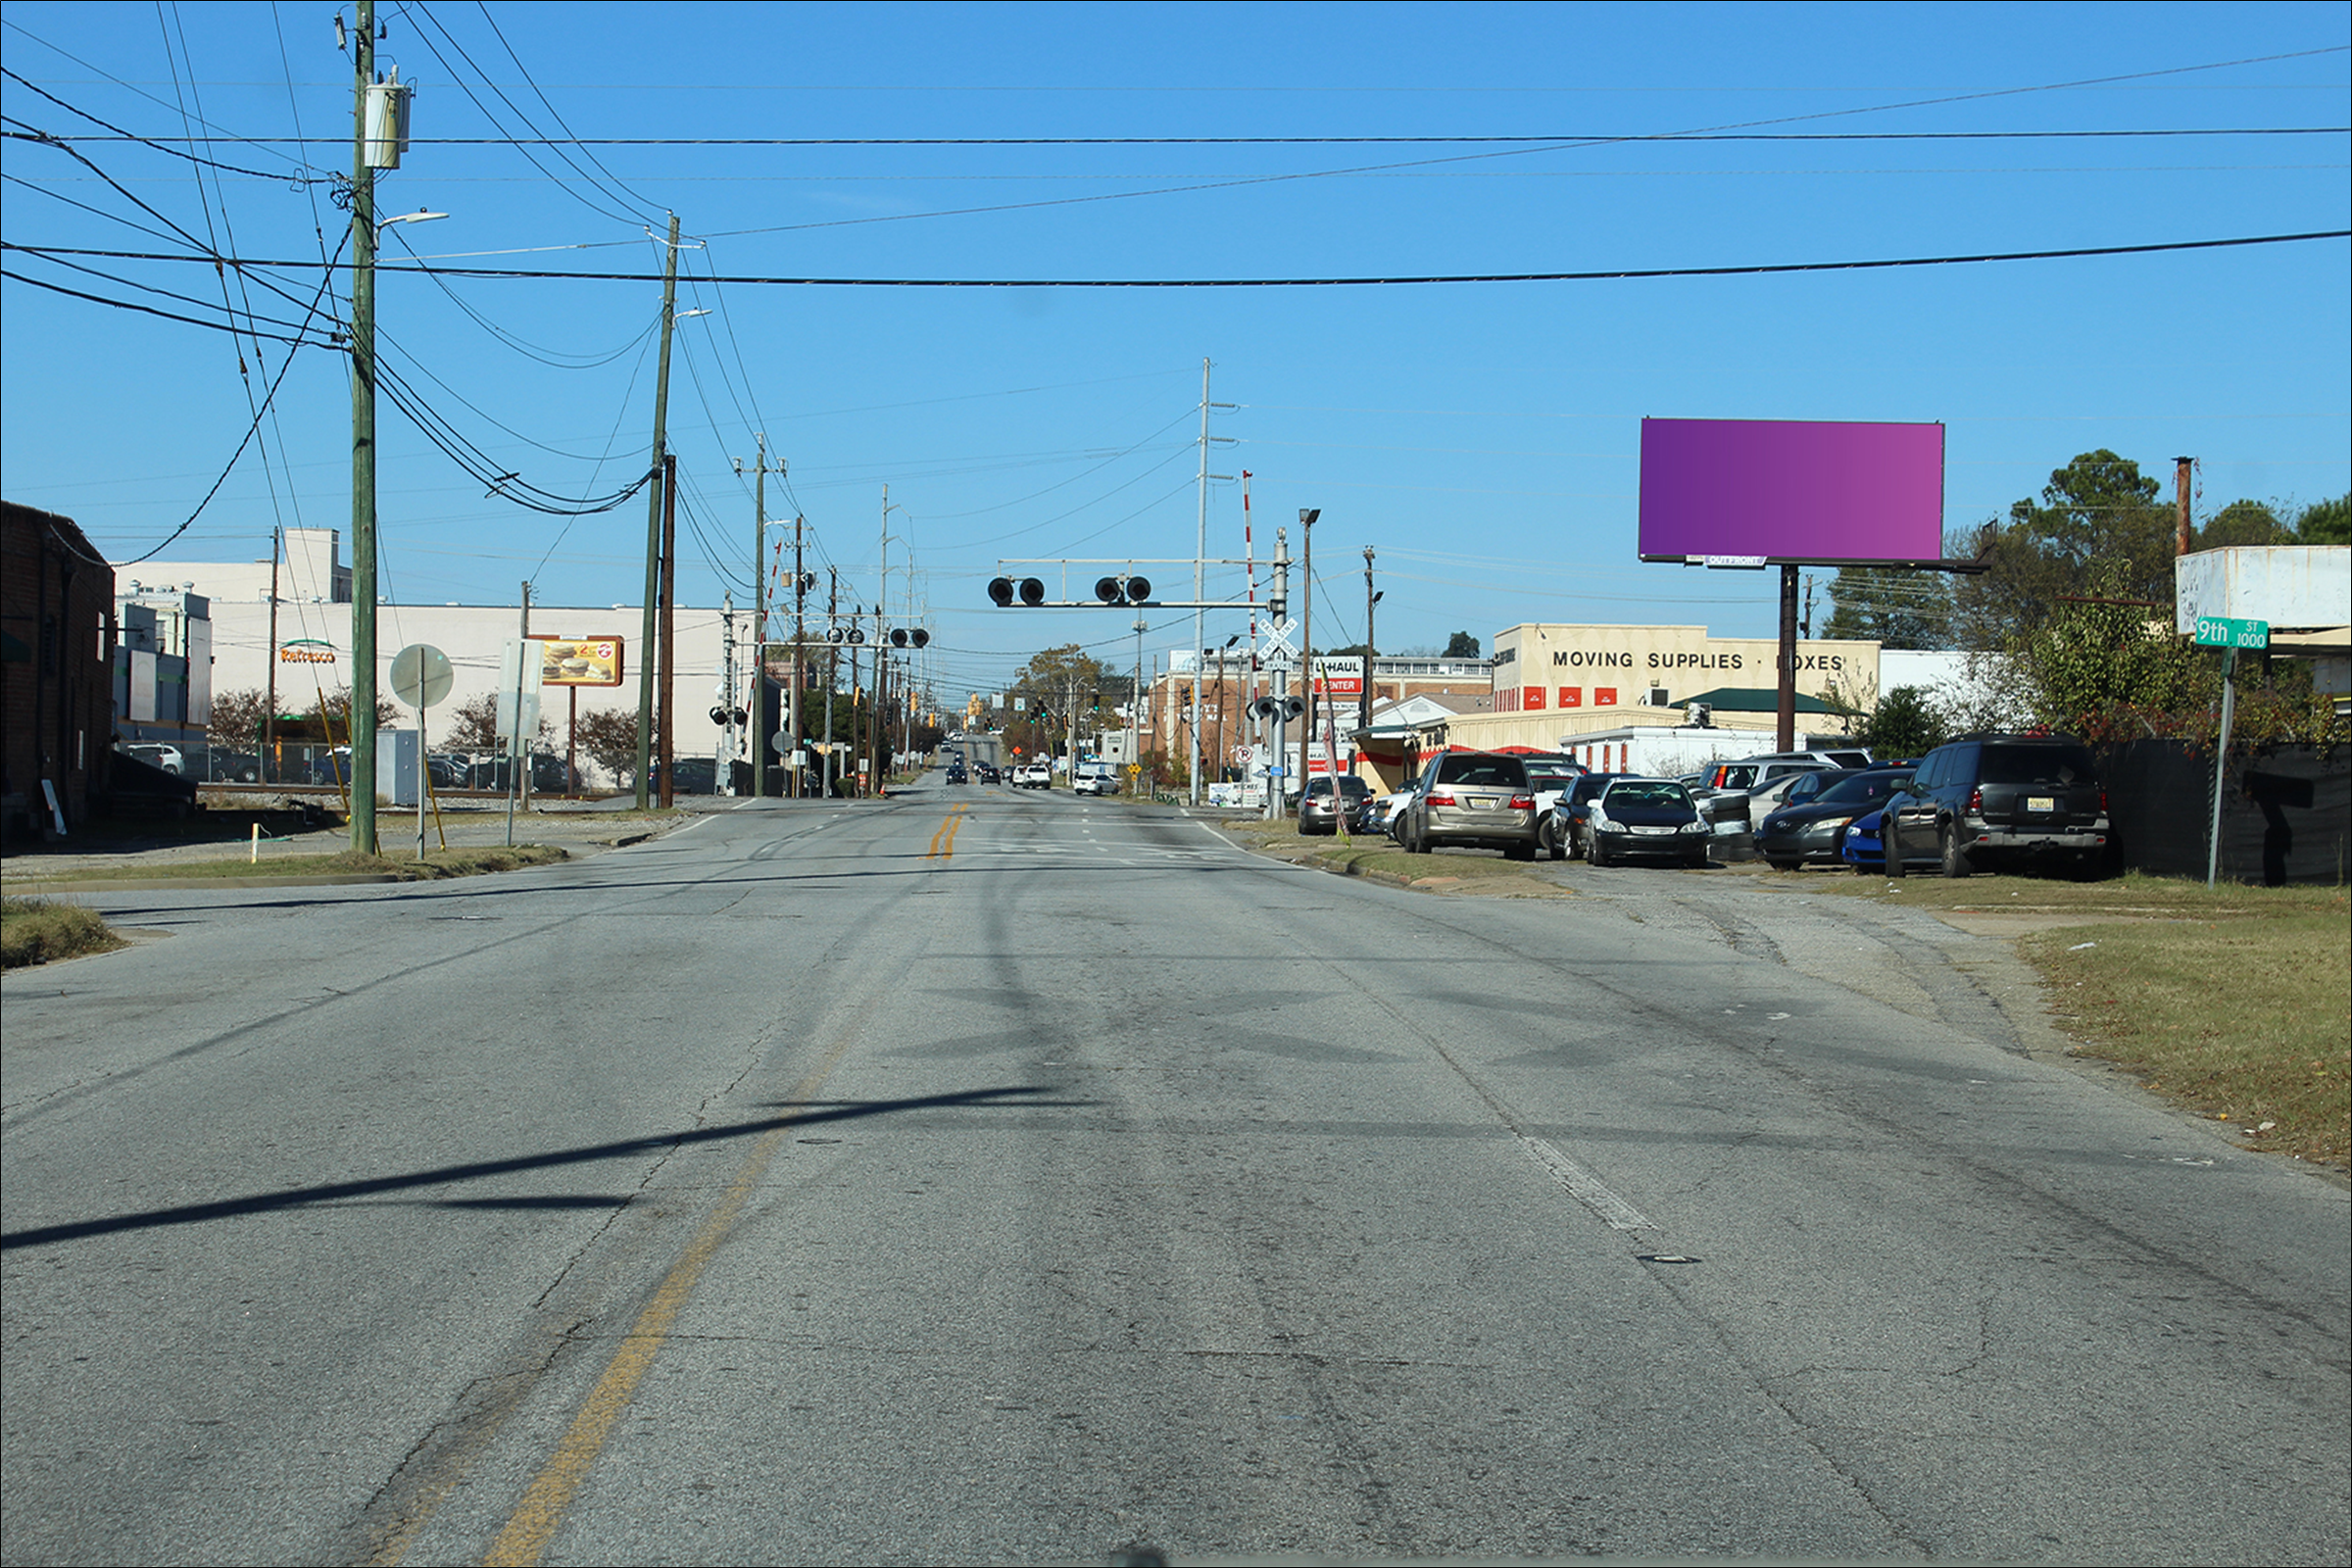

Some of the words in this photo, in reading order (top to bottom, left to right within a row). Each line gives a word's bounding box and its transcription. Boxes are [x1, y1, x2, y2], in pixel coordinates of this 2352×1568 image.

[1709, 556, 1761, 564] OUTFRONT
[1260, 619, 1296, 658] CROSSING
[2198, 619, 2228, 642] 9th
[2245, 621, 2258, 632] ST
[2236, 632, 2266, 648] 1000
[280, 648, 335, 663] Refresco
[1553, 651, 1634, 667] MOVING
[1647, 653, 1743, 669] SUPPLIES
[1777, 655, 1842, 670] OXES
